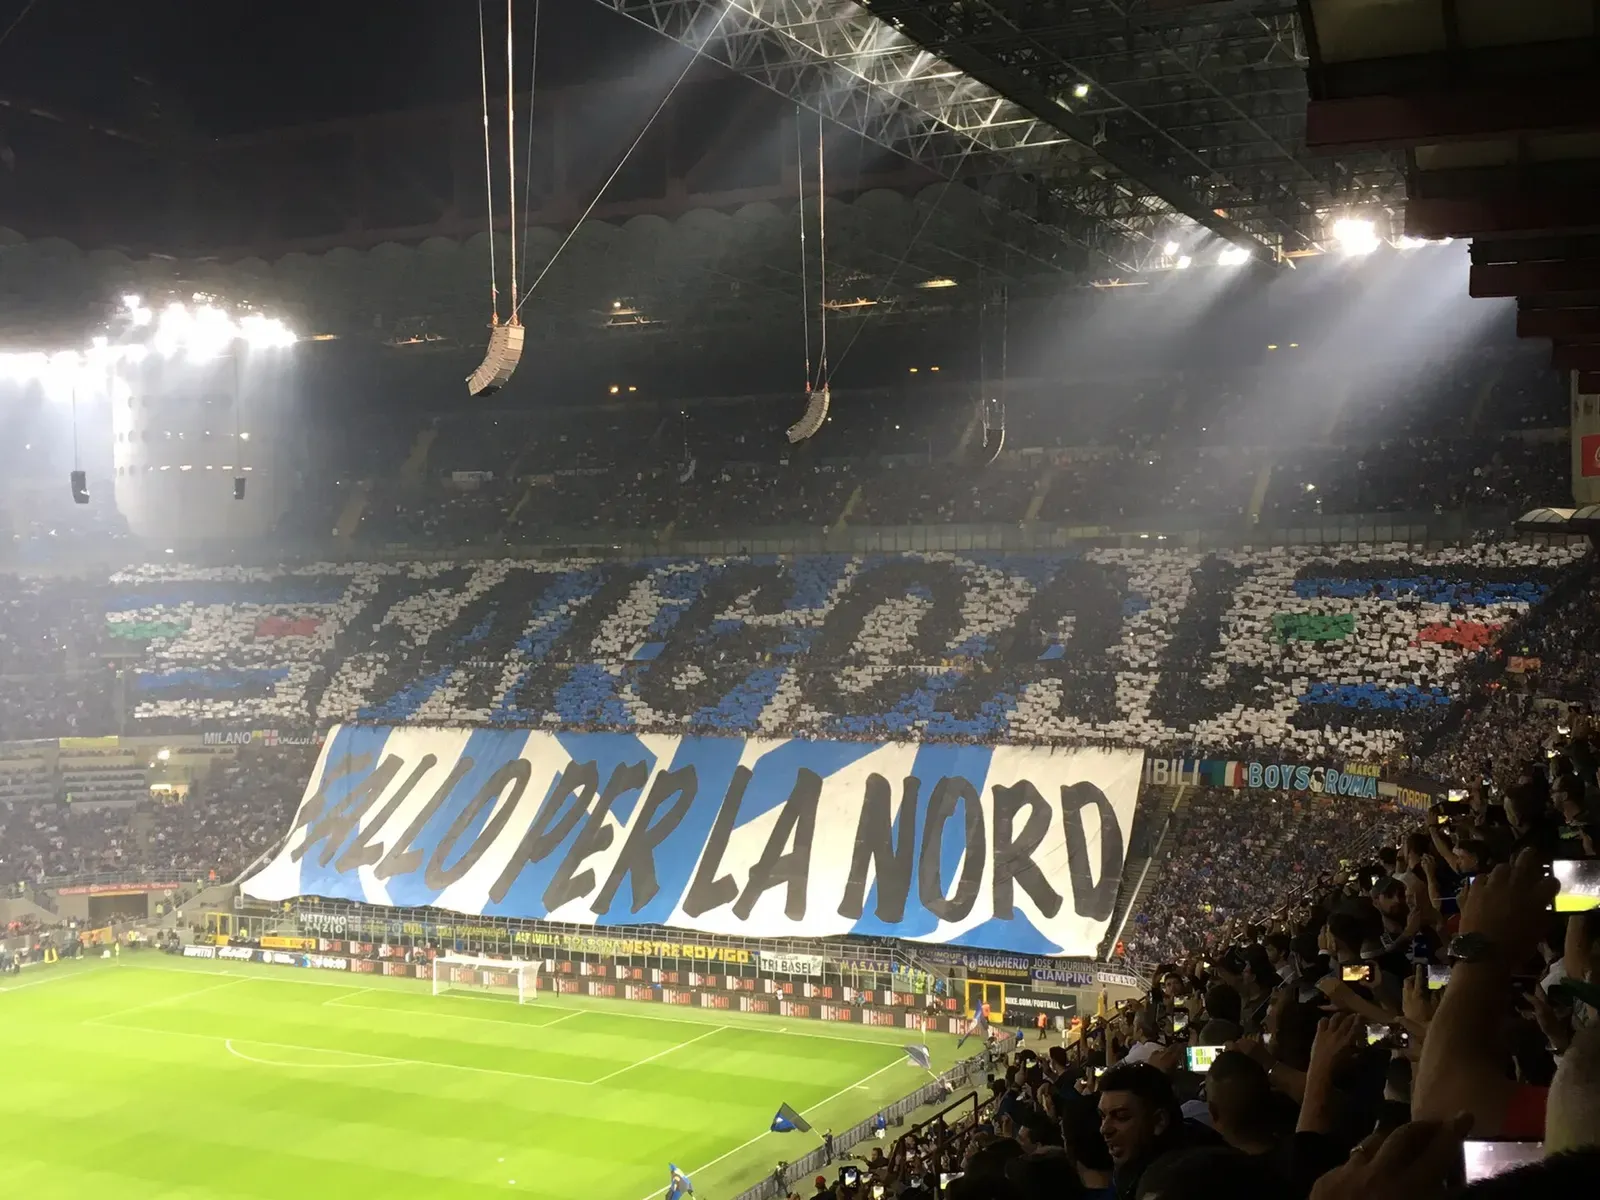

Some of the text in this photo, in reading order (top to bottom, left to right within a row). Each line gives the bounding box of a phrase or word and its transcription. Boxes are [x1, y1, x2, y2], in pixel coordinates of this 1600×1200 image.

[204, 731, 252, 745] MILANO
[1248, 761, 1378, 799] BOYS ROMA
[291, 752, 1125, 924] FALLO PER LA NORD
[300, 912, 347, 926] NETTUNO
[303, 921, 344, 934] ANZIO
[621, 939, 680, 958] MESTRE
[682, 943, 749, 963] ROVIGO
[762, 958, 778, 972] TRI
[840, 959, 889, 973] MASATE
[978, 954, 1029, 970] BRUGHERIO
